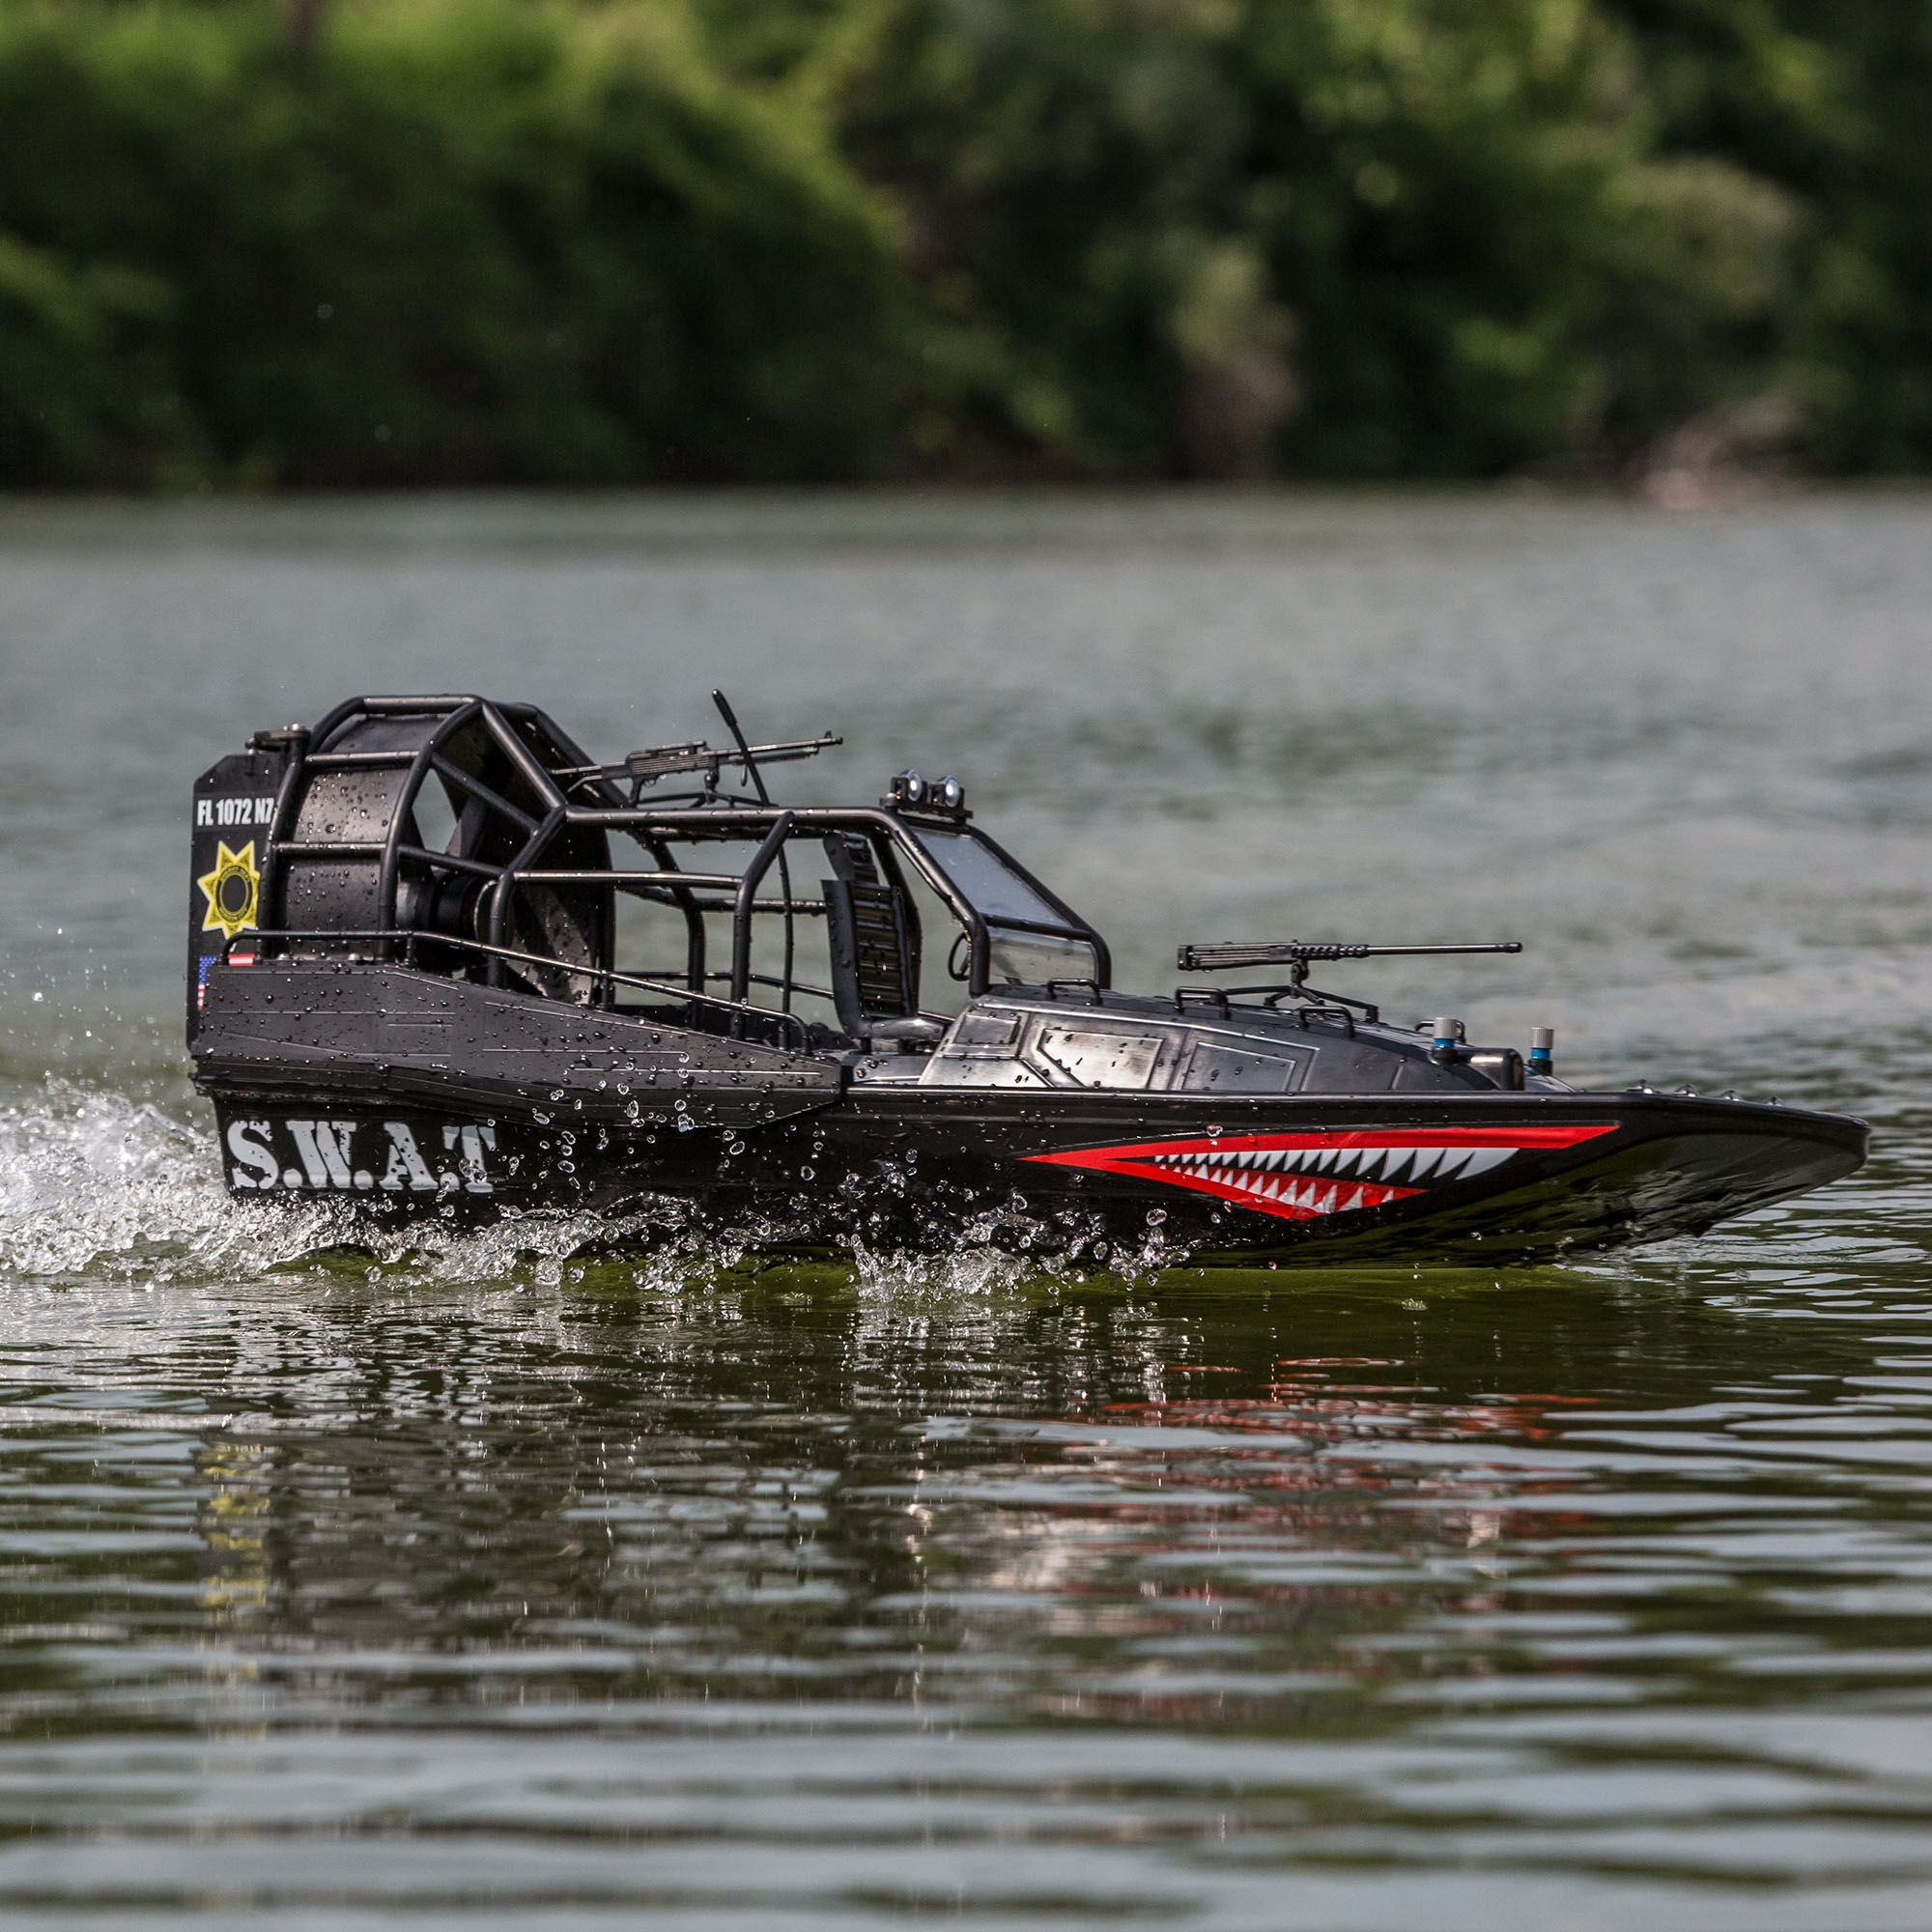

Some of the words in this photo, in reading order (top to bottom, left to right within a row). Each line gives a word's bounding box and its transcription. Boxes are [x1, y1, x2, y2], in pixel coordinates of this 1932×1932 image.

[197, 800, 213, 826] FL
[216, 798, 252, 825] 1072
[227, 1121, 497, 1193] S.W.A.T
